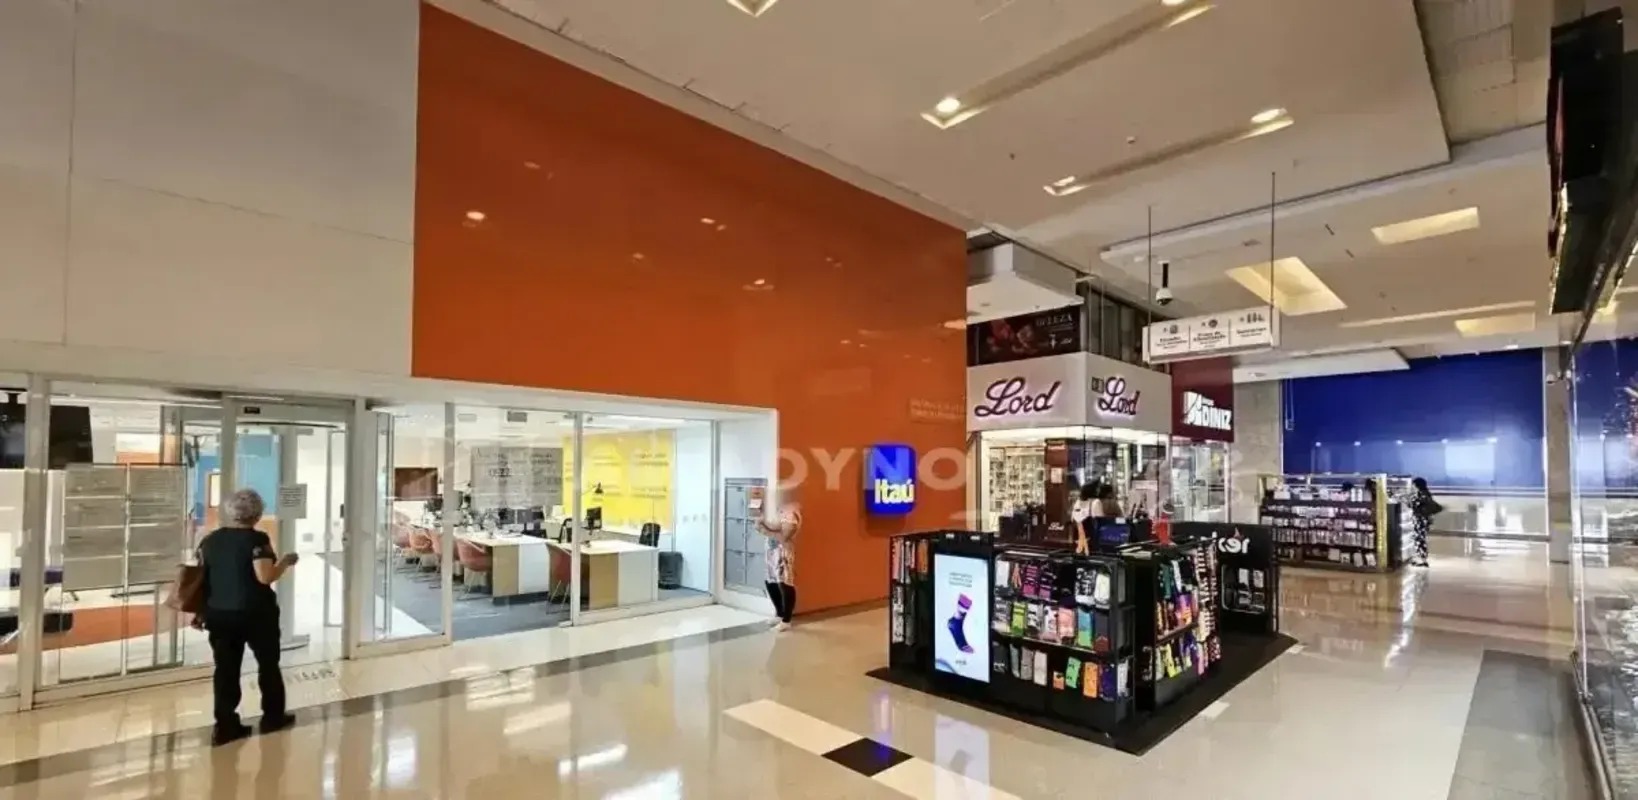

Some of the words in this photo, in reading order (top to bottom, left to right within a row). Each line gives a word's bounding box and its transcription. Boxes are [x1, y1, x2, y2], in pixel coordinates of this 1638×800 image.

[974, 376, 1062, 417] Lord
[1097, 376, 1141, 415] Lord
[1201, 404, 1232, 430] DINIZ
[874, 478, 915, 504] Itaú
